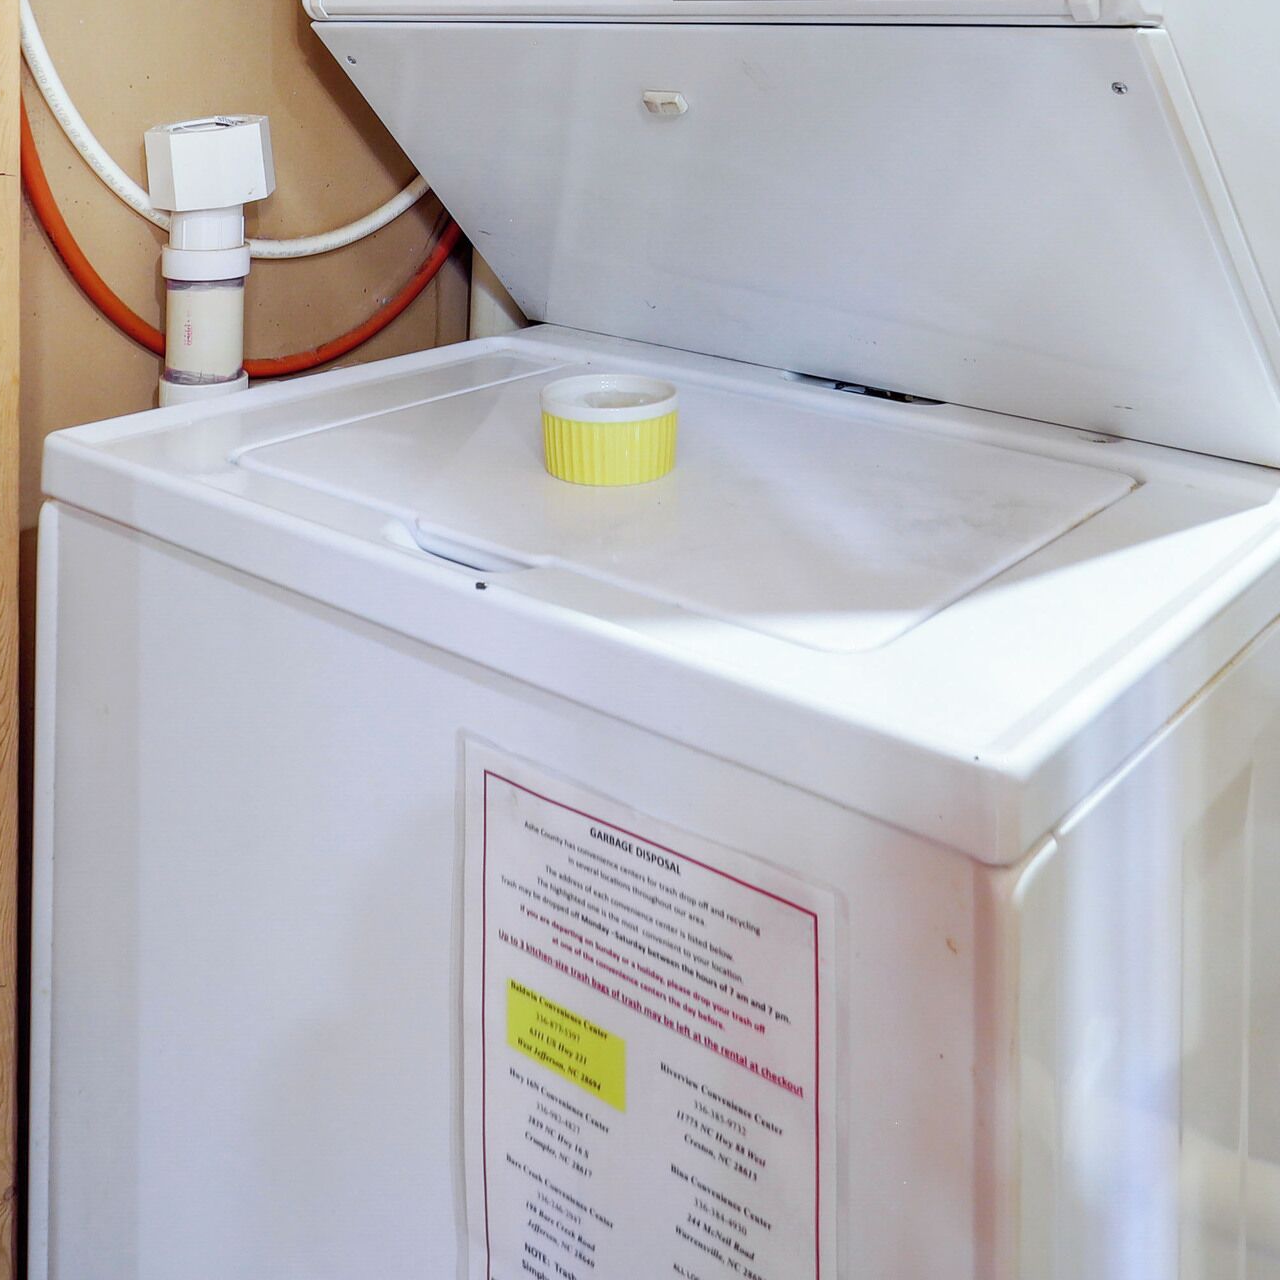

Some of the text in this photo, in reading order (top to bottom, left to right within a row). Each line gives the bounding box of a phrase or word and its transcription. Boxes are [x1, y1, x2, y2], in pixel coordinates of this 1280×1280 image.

[590, 827, 680, 875] GARBAGE DISPOSAL
[498, 928, 803, 1097] Up to 3 kitchen size trash bags of trash may be left at the rental at checkout
[501, 875, 516, 889] Trash
[518, 885, 532, 898] may
[533, 890, 540, 901] be
[542, 895, 568, 916] dropped
[570, 908, 579, 920] off
[581, 913, 608, 935] Monday
[647, 947, 679, 969] between
[681, 962, 693, 976] the
[695, 969, 717, 988] hours
[719, 982, 726, 993] of
[729, 986, 733, 996] 7
[736, 991, 748, 1004] am
[750, 997, 765, 1012] and
[768, 1005, 772, 1016] 7
[775, 1011, 791, 1027] pm.
[520, 903, 765, 1035] If you are departing on Sunday or a holiday, please drop your trash off
[552, 935, 725, 1031] at one of the convenience centers the day before.
